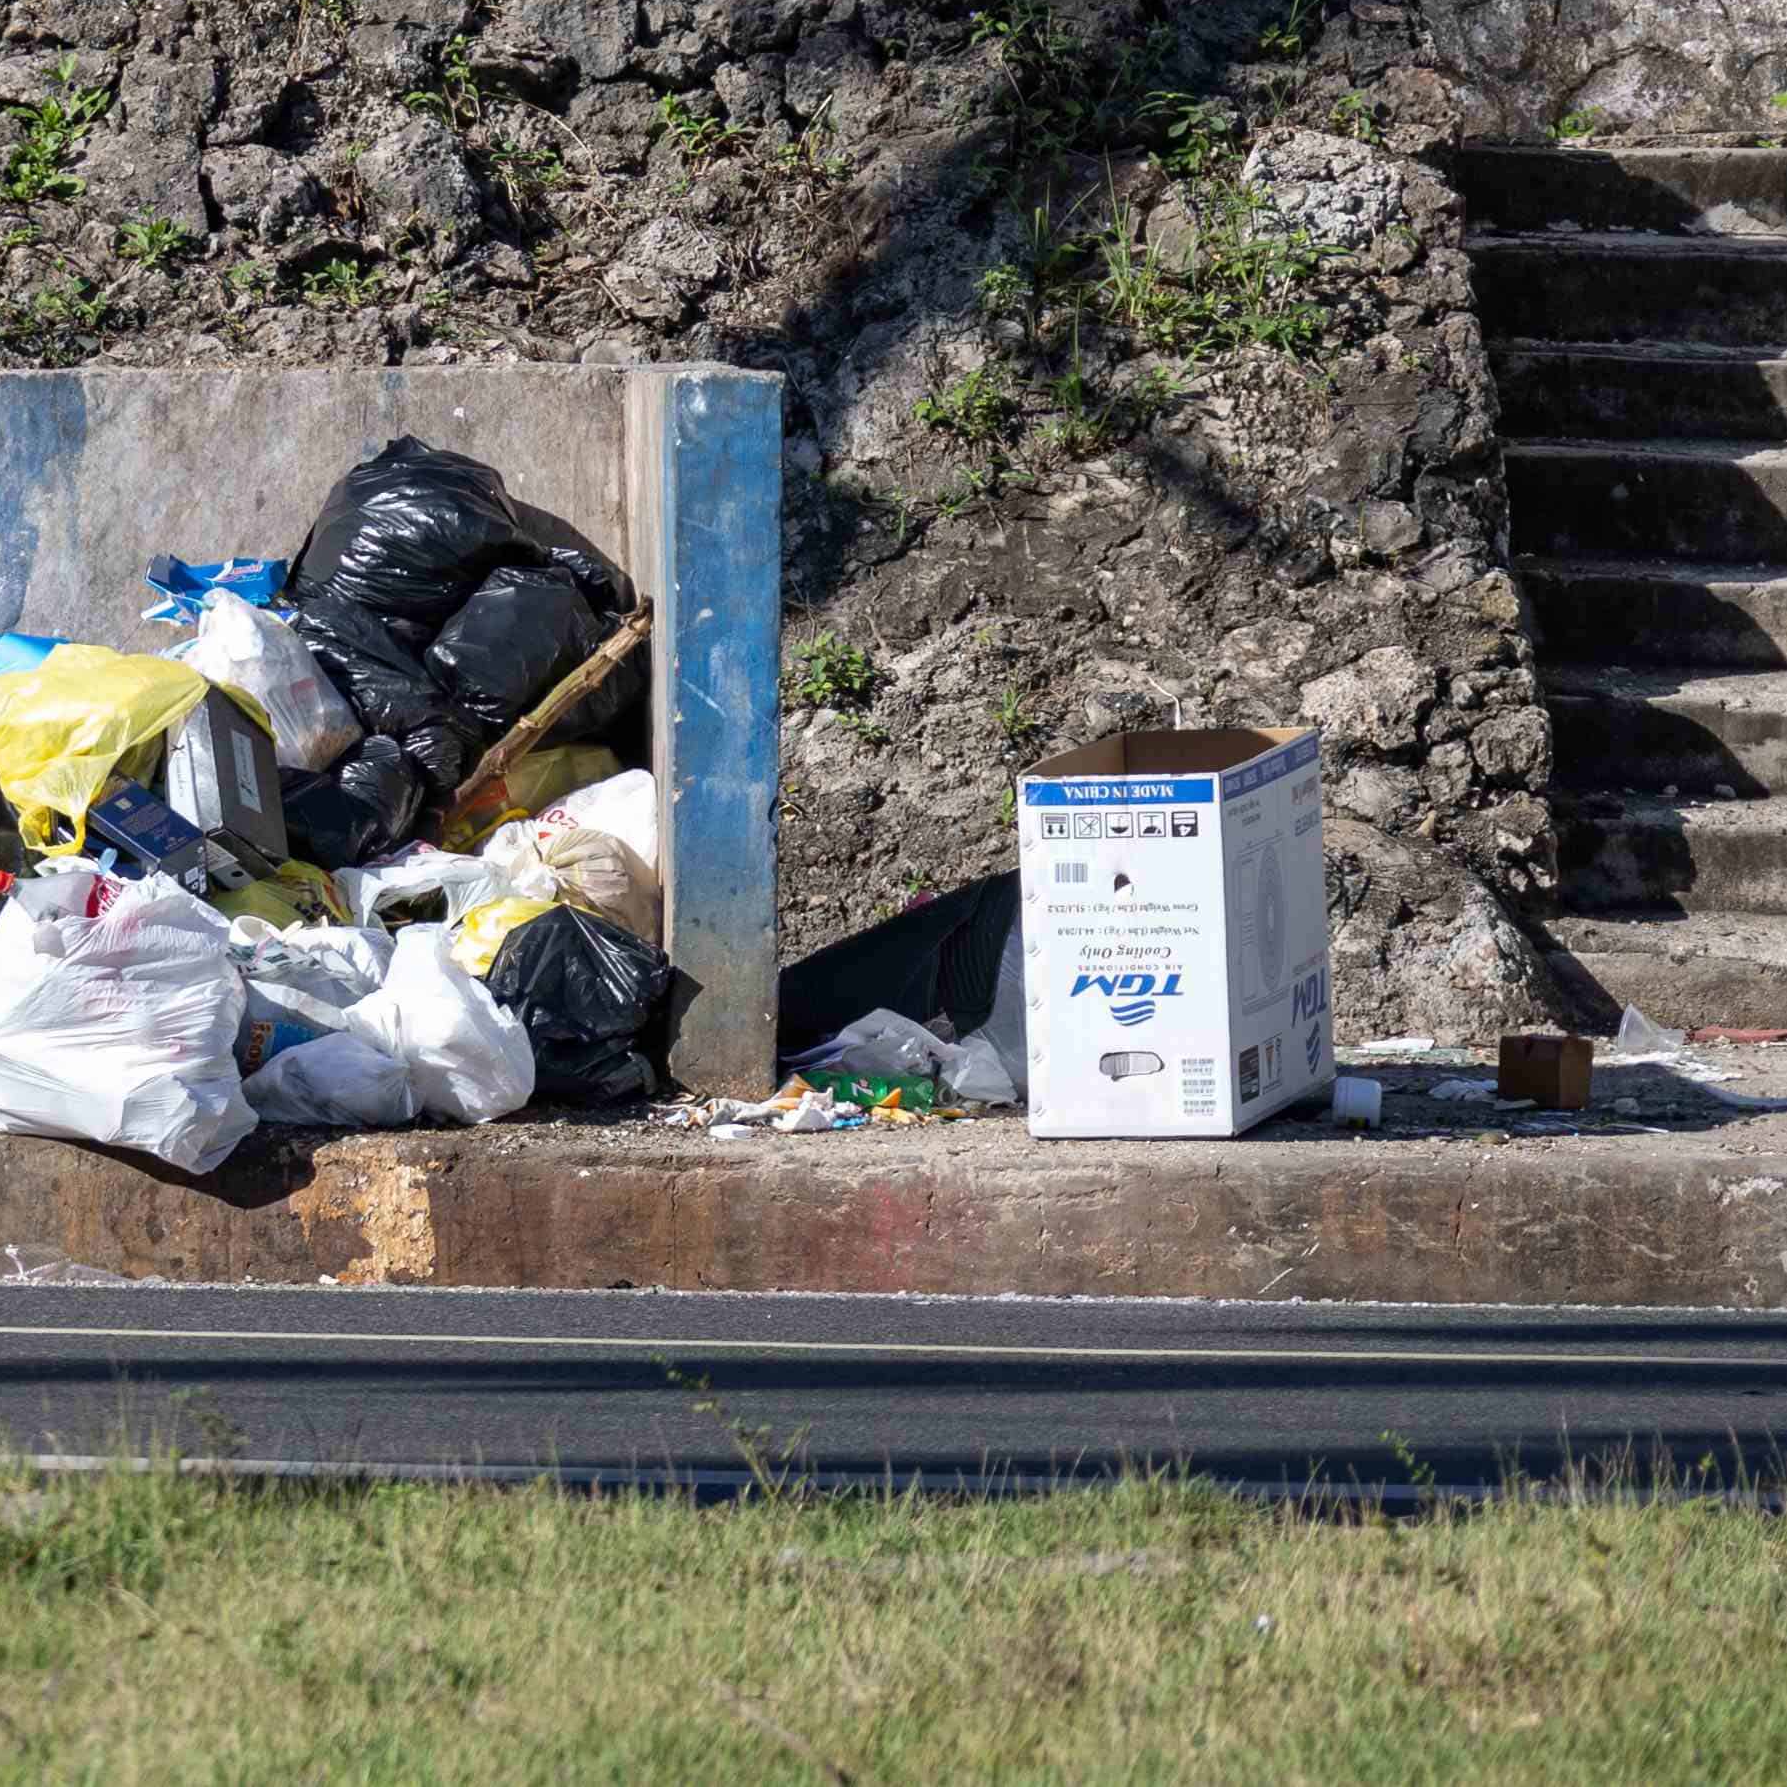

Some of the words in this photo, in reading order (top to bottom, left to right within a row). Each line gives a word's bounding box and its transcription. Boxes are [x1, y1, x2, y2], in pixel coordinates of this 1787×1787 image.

[1063, 785, 1110, 800] CHINA
[1112, 785, 1127, 799] IN
[1130, 784, 1174, 799] MADE
[1139, 902, 1171, 913] Weight
[1150, 926, 1182, 936] Weight
[1079, 944, 1113, 959] Only
[1116, 944, 1172, 959] Cooling
[1077, 964, 1159, 972] CONDITIONERS
[1070, 973, 1184, 997] TGM
[1293, 966, 1328, 1029] TGM
